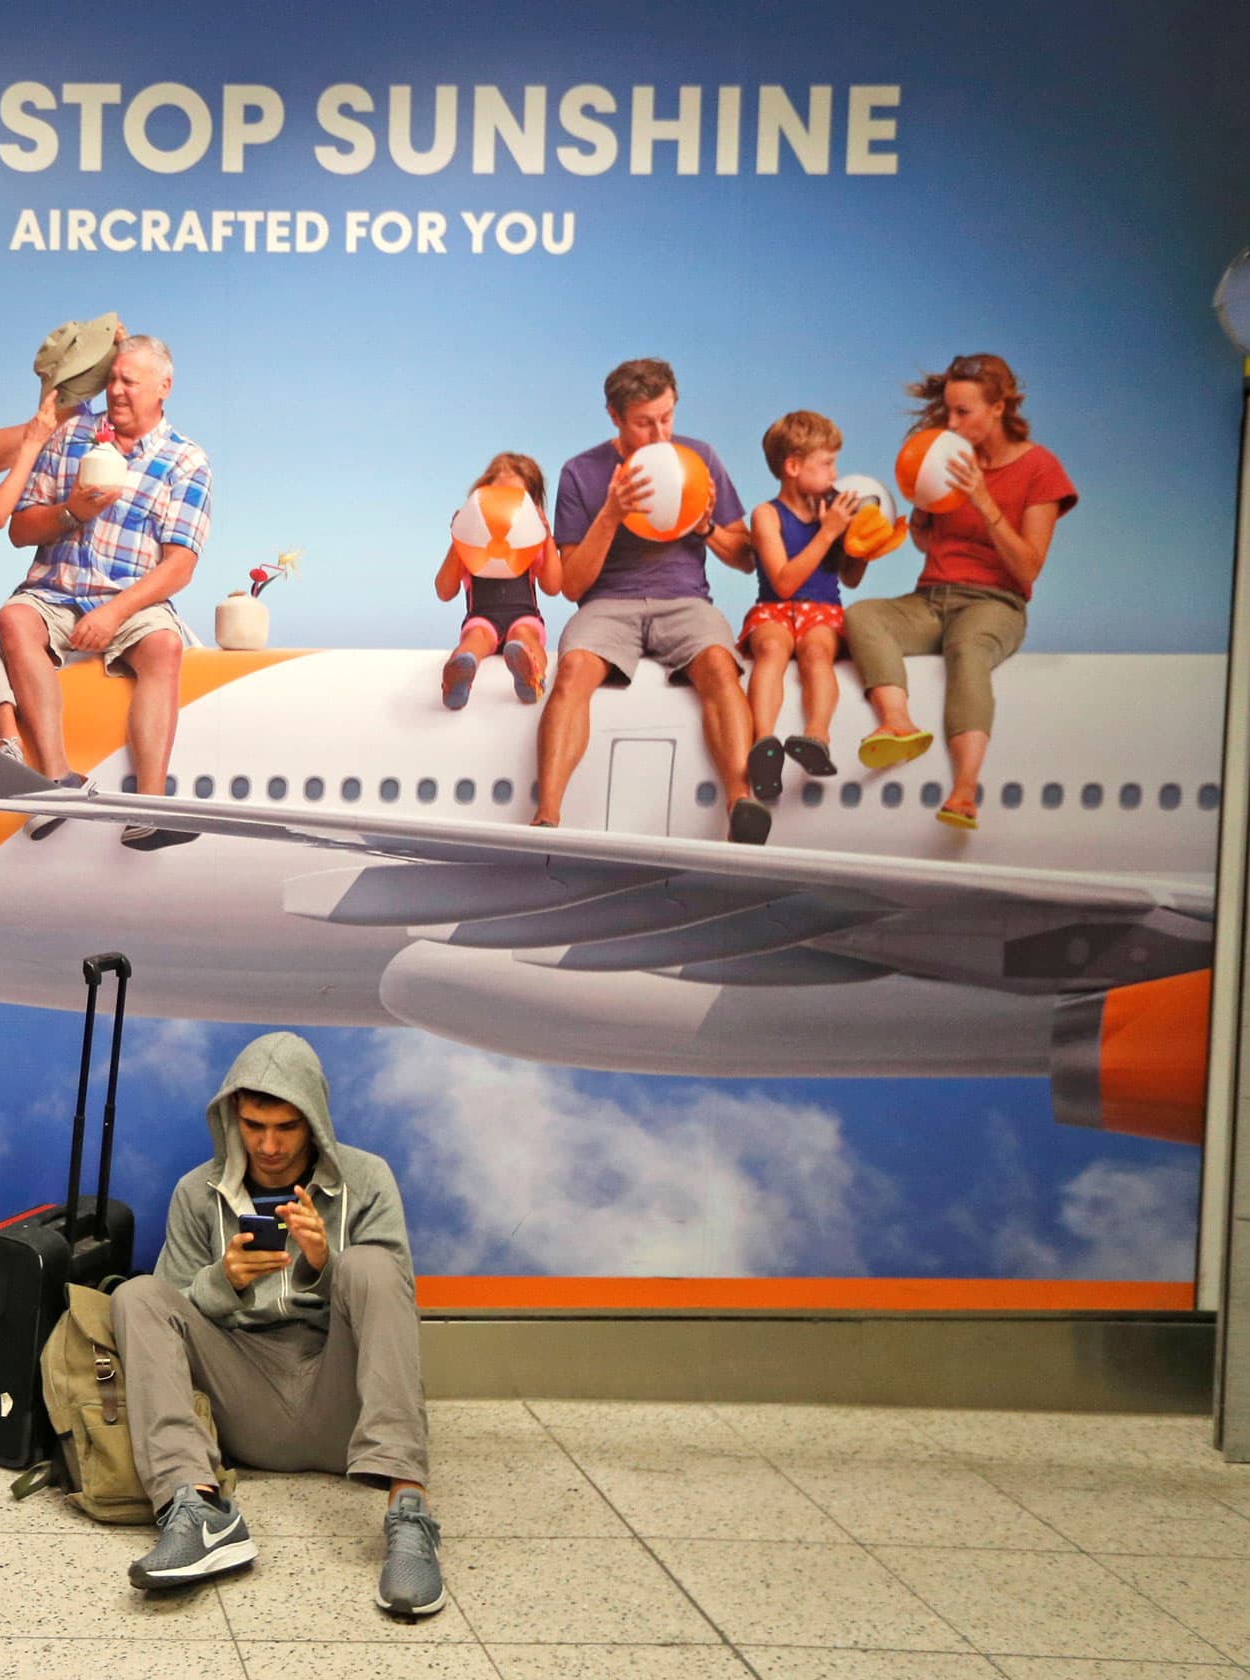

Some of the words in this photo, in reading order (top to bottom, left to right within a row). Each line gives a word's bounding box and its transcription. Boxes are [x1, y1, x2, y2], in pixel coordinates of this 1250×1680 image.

[314, 83, 899, 176] SUNSHINE
[9, 208, 330, 254] AIRCRAFTED
[344, 209, 448, 255] FOR
[459, 209, 575, 256] YOU
